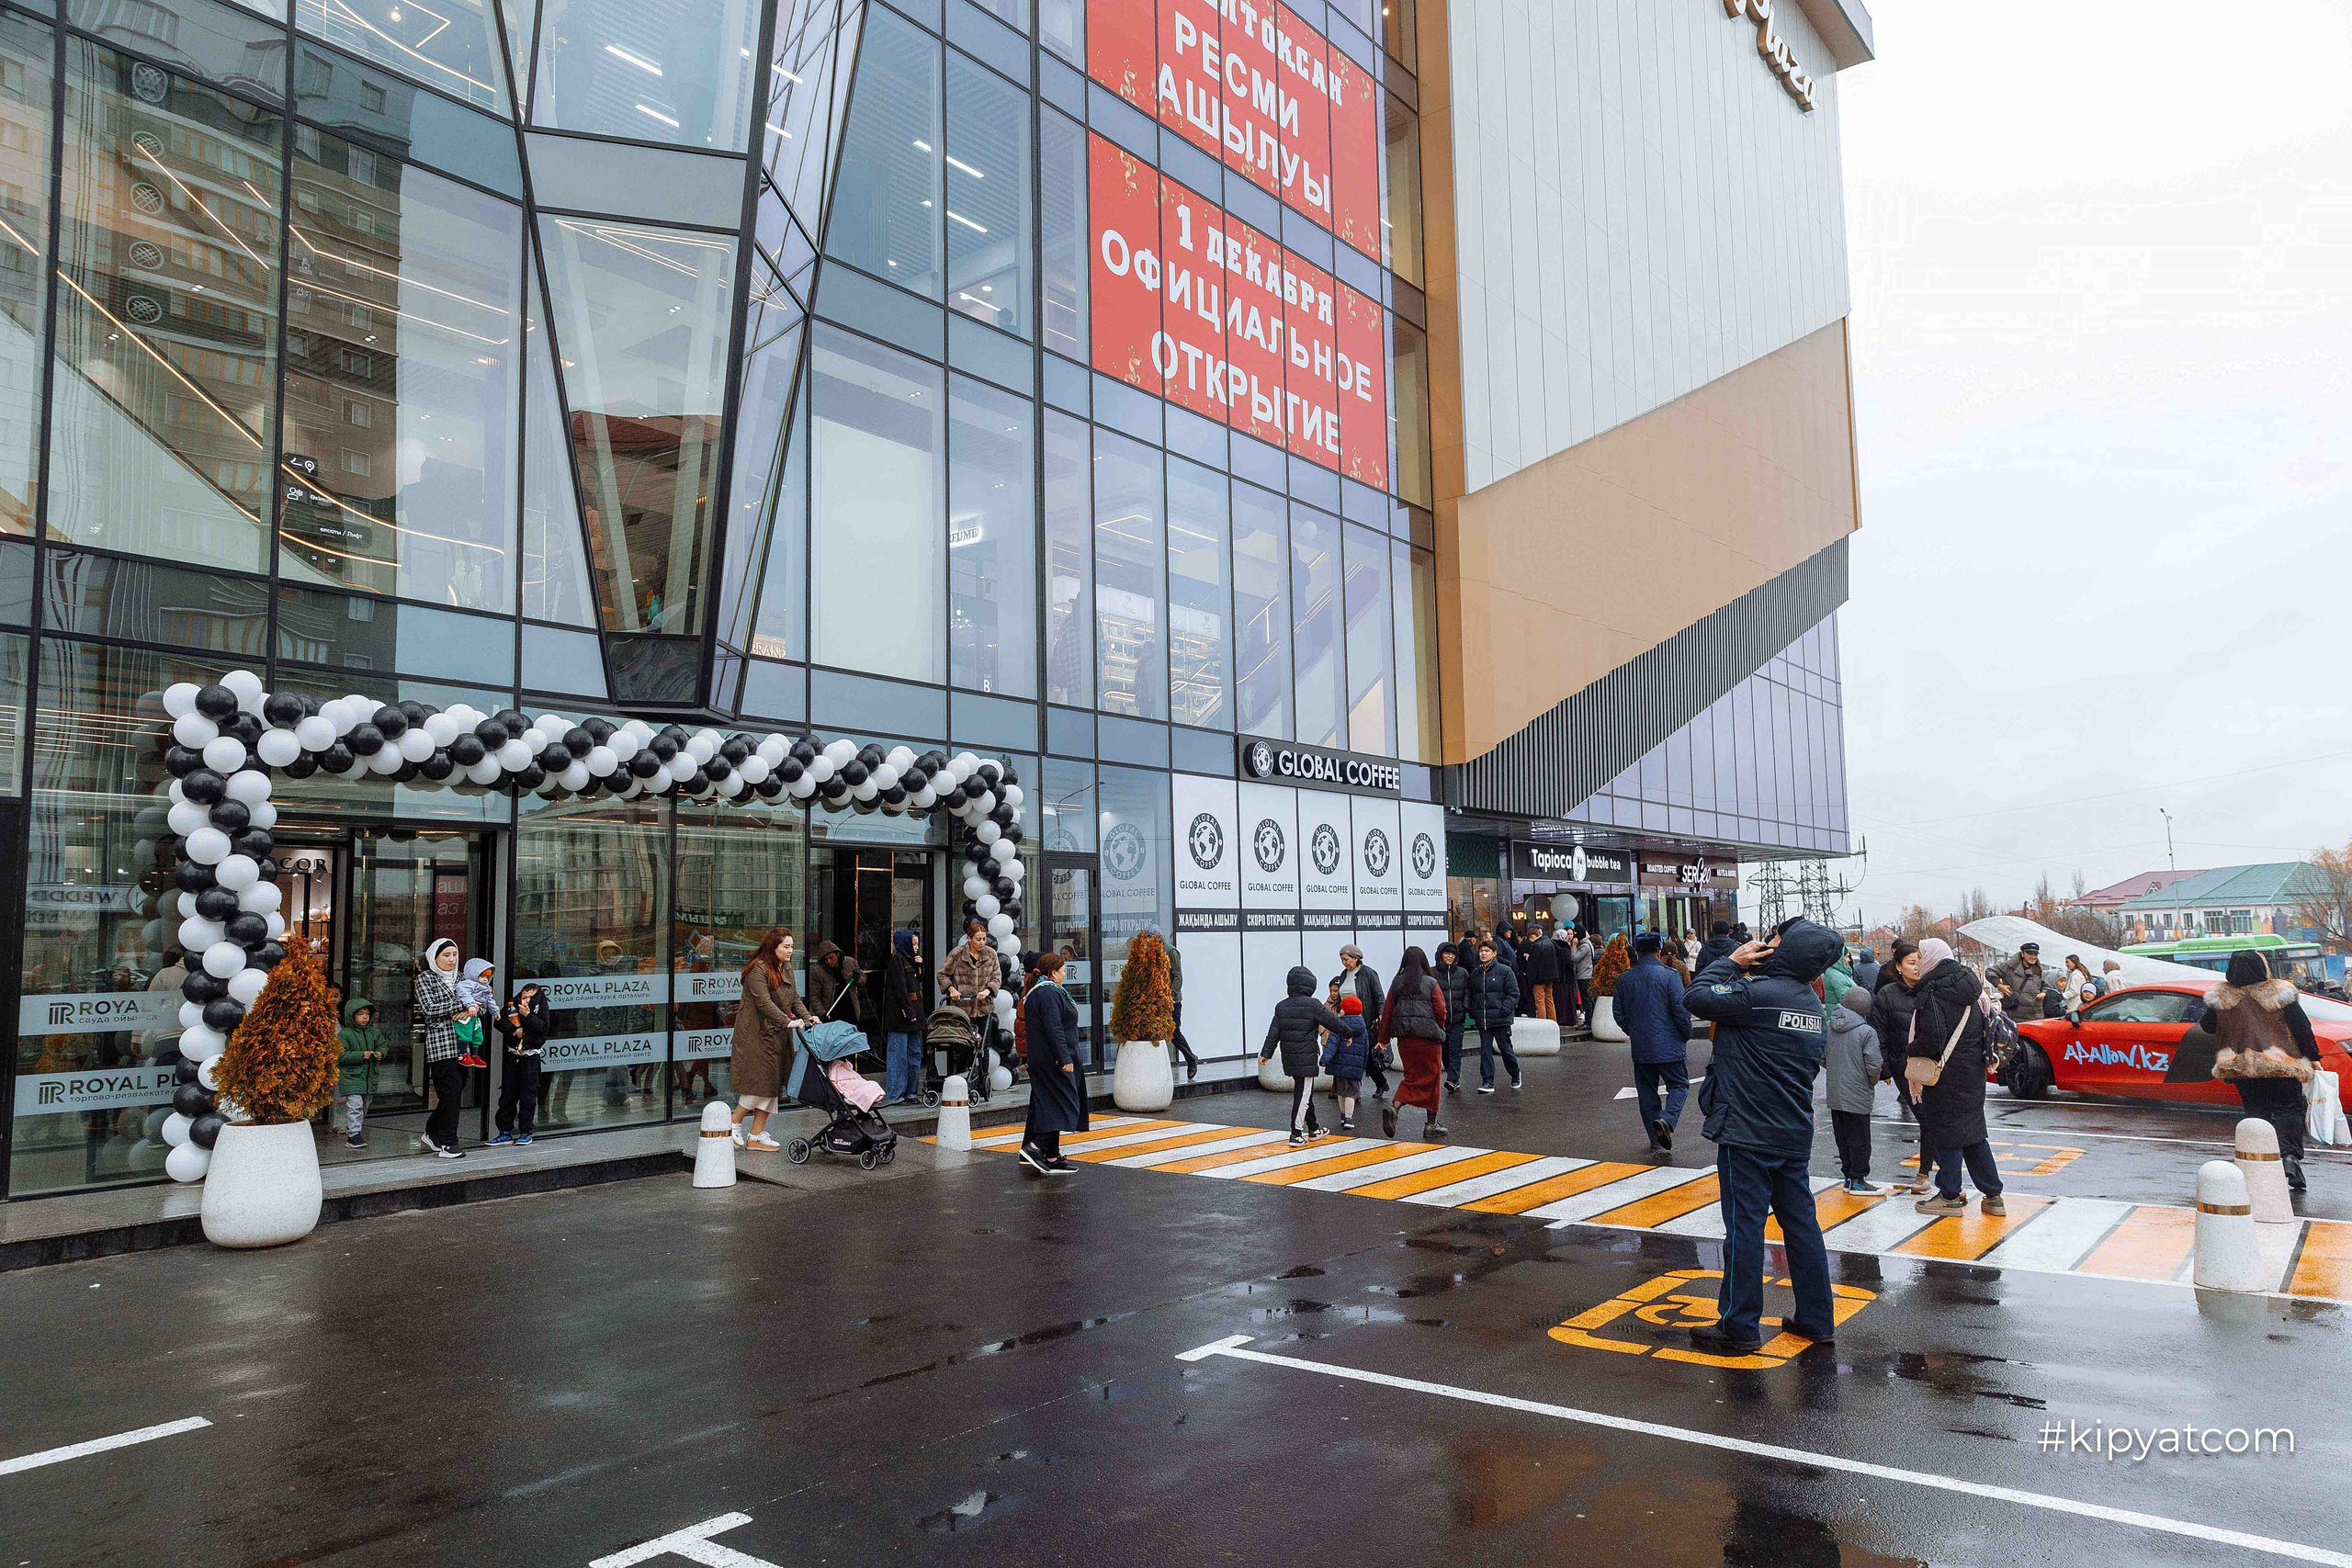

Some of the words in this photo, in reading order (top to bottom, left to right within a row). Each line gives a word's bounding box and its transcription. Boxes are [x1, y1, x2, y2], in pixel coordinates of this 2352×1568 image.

[1174, 10, 1299, 138] РЕСМИ
[1155, 62, 1330, 214] АШЫЛУЫ
[1175, 204, 1193, 253] 1
[1206, 225, 1333, 327] ДЕКАБРЯ
[1101, 229, 1373, 403] ОФИЦИАЛЬНОЕ
[1150, 331, 1343, 457] ОТКРЫТИЕ
[1279, 750, 1343, 782] GLOBAL
[1347, 761, 1399, 790] COFFEE
[1193, 814, 1217, 828] GLOBAL
[1258, 819, 1279, 832] GLOBAL
[1109, 824, 1140, 839] GLOBAL
[1315, 824, 1335, 837] GLOBAL
[1367, 829, 1385, 841] GLOBAL
[1414, 834, 1431, 846] GLOBAL
[1194, 855, 1218, 869] COFFEE
[1259, 859, 1281, 871] COFFEE
[1532, 849, 1572, 873] Tapioca
[1587, 854, 1609, 869] bubble
[1610, 859, 1621, 870] tea
[1110, 866, 1140, 879] COFFEE
[1317, 863, 1336, 874] COFFEE
[1369, 865, 1386, 876] COFFEE
[1416, 868, 1432, 879] COFFEE
[1180, 880, 1205, 890] GLOBAL
[1208, 881, 1231, 890] COFFEE
[1248, 883, 1272, 892] GLOBAL
[1272, 884, 1294, 892] COFFEE
[1306, 885, 1328, 893] GLOBAL
[1329, 886, 1348, 894] COFFEE
[1360, 886, 1379, 895] GLOBAL
[1380, 887, 1397, 896] COFFEE
[1127, 887, 1155, 897] COFFEE
[1427, 888, 1442, 897] COFFEE
[1179, 914, 1213, 928] ЖАҚЫНДА
[1214, 914, 1238, 927] АШЫЛУ
[1247, 914, 1265, 926] СКОРО
[1266, 914, 1295, 926] ОТКРЫТИЕ
[1408, 915, 1421, 925] СКОРО
[554, 983, 601, 996] ROYAL
[605, 980, 650, 993] PLAZA
[708, 977, 741, 989] ROYA
[79, 1016, 109, 1025] сауда
[1781, 1014, 1820, 1031] POLISIA
[548, 1043, 600, 1058] ROYAL
[604, 1039, 651, 1054] PLAZA
[70, 1076, 149, 1095] ROYAL
